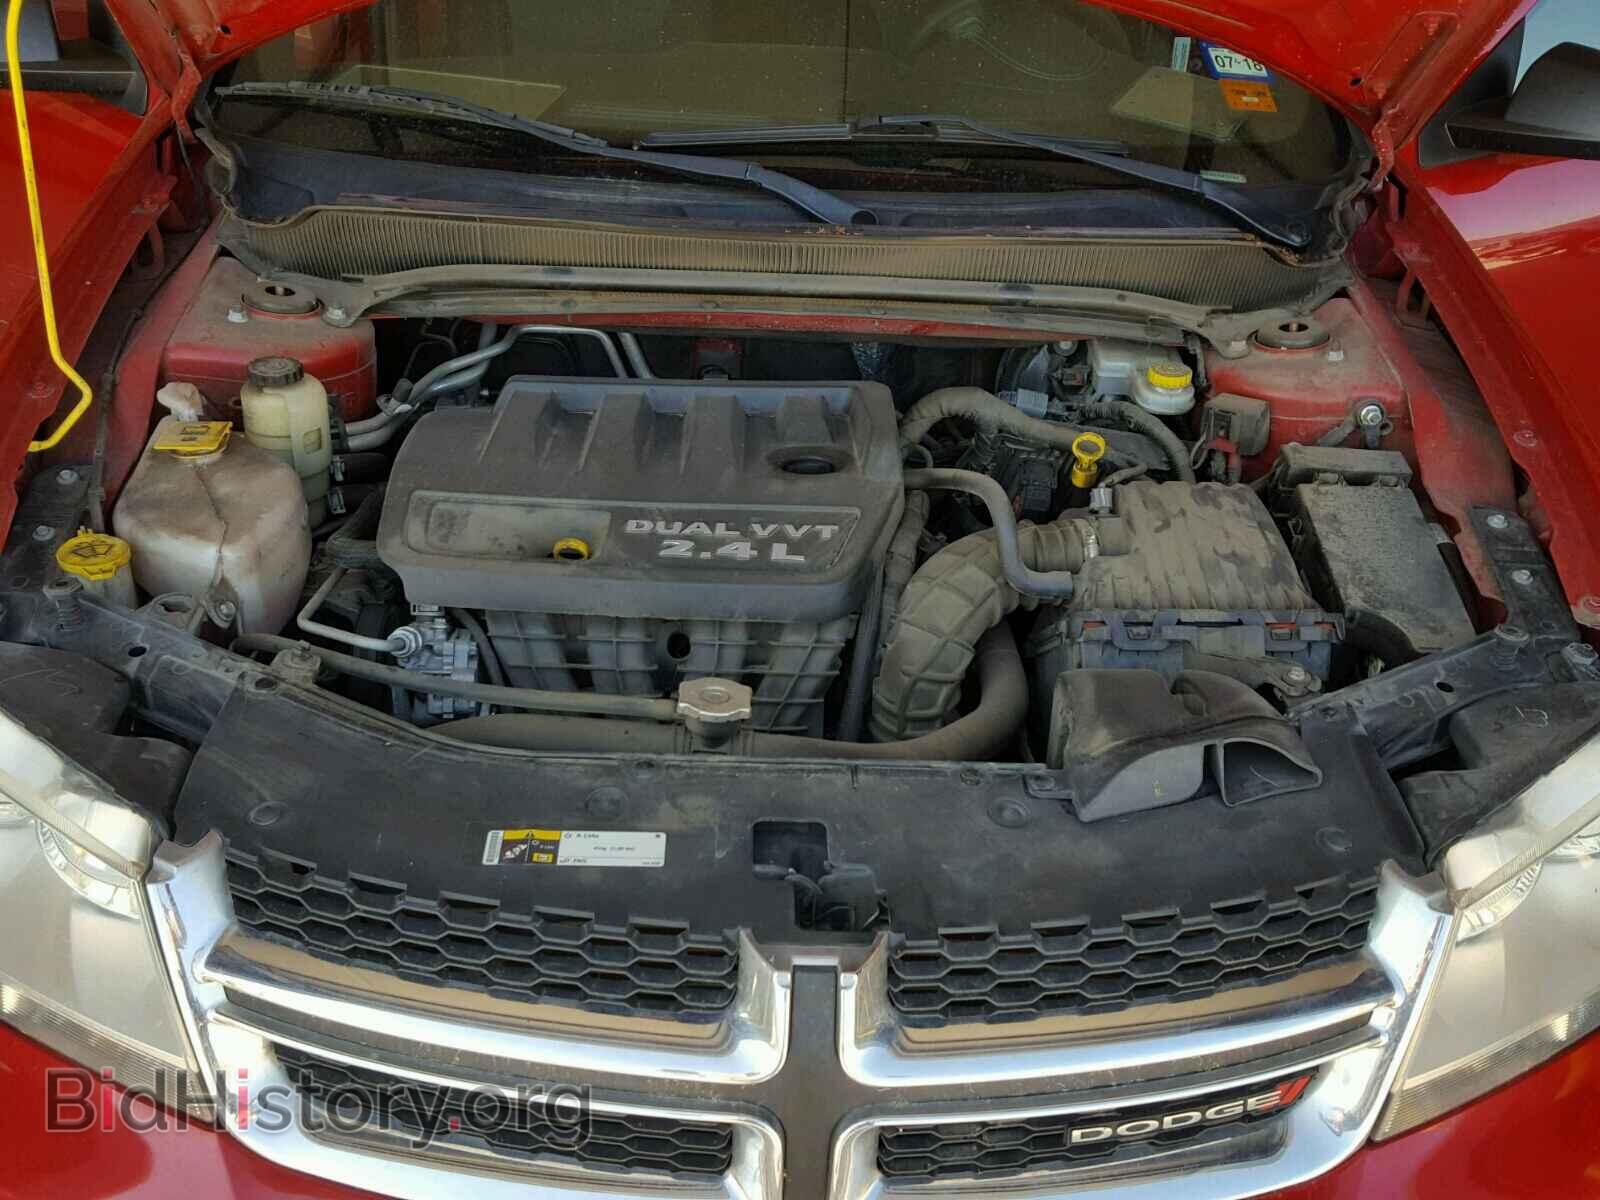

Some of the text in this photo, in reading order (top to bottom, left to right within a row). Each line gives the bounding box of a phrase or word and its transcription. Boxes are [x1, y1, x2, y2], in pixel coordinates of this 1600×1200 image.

[624, 519, 840, 539] DUAL VVT
[659, 539, 805, 561] 2.4 L
[1071, 1089, 1282, 1144] DODGE
